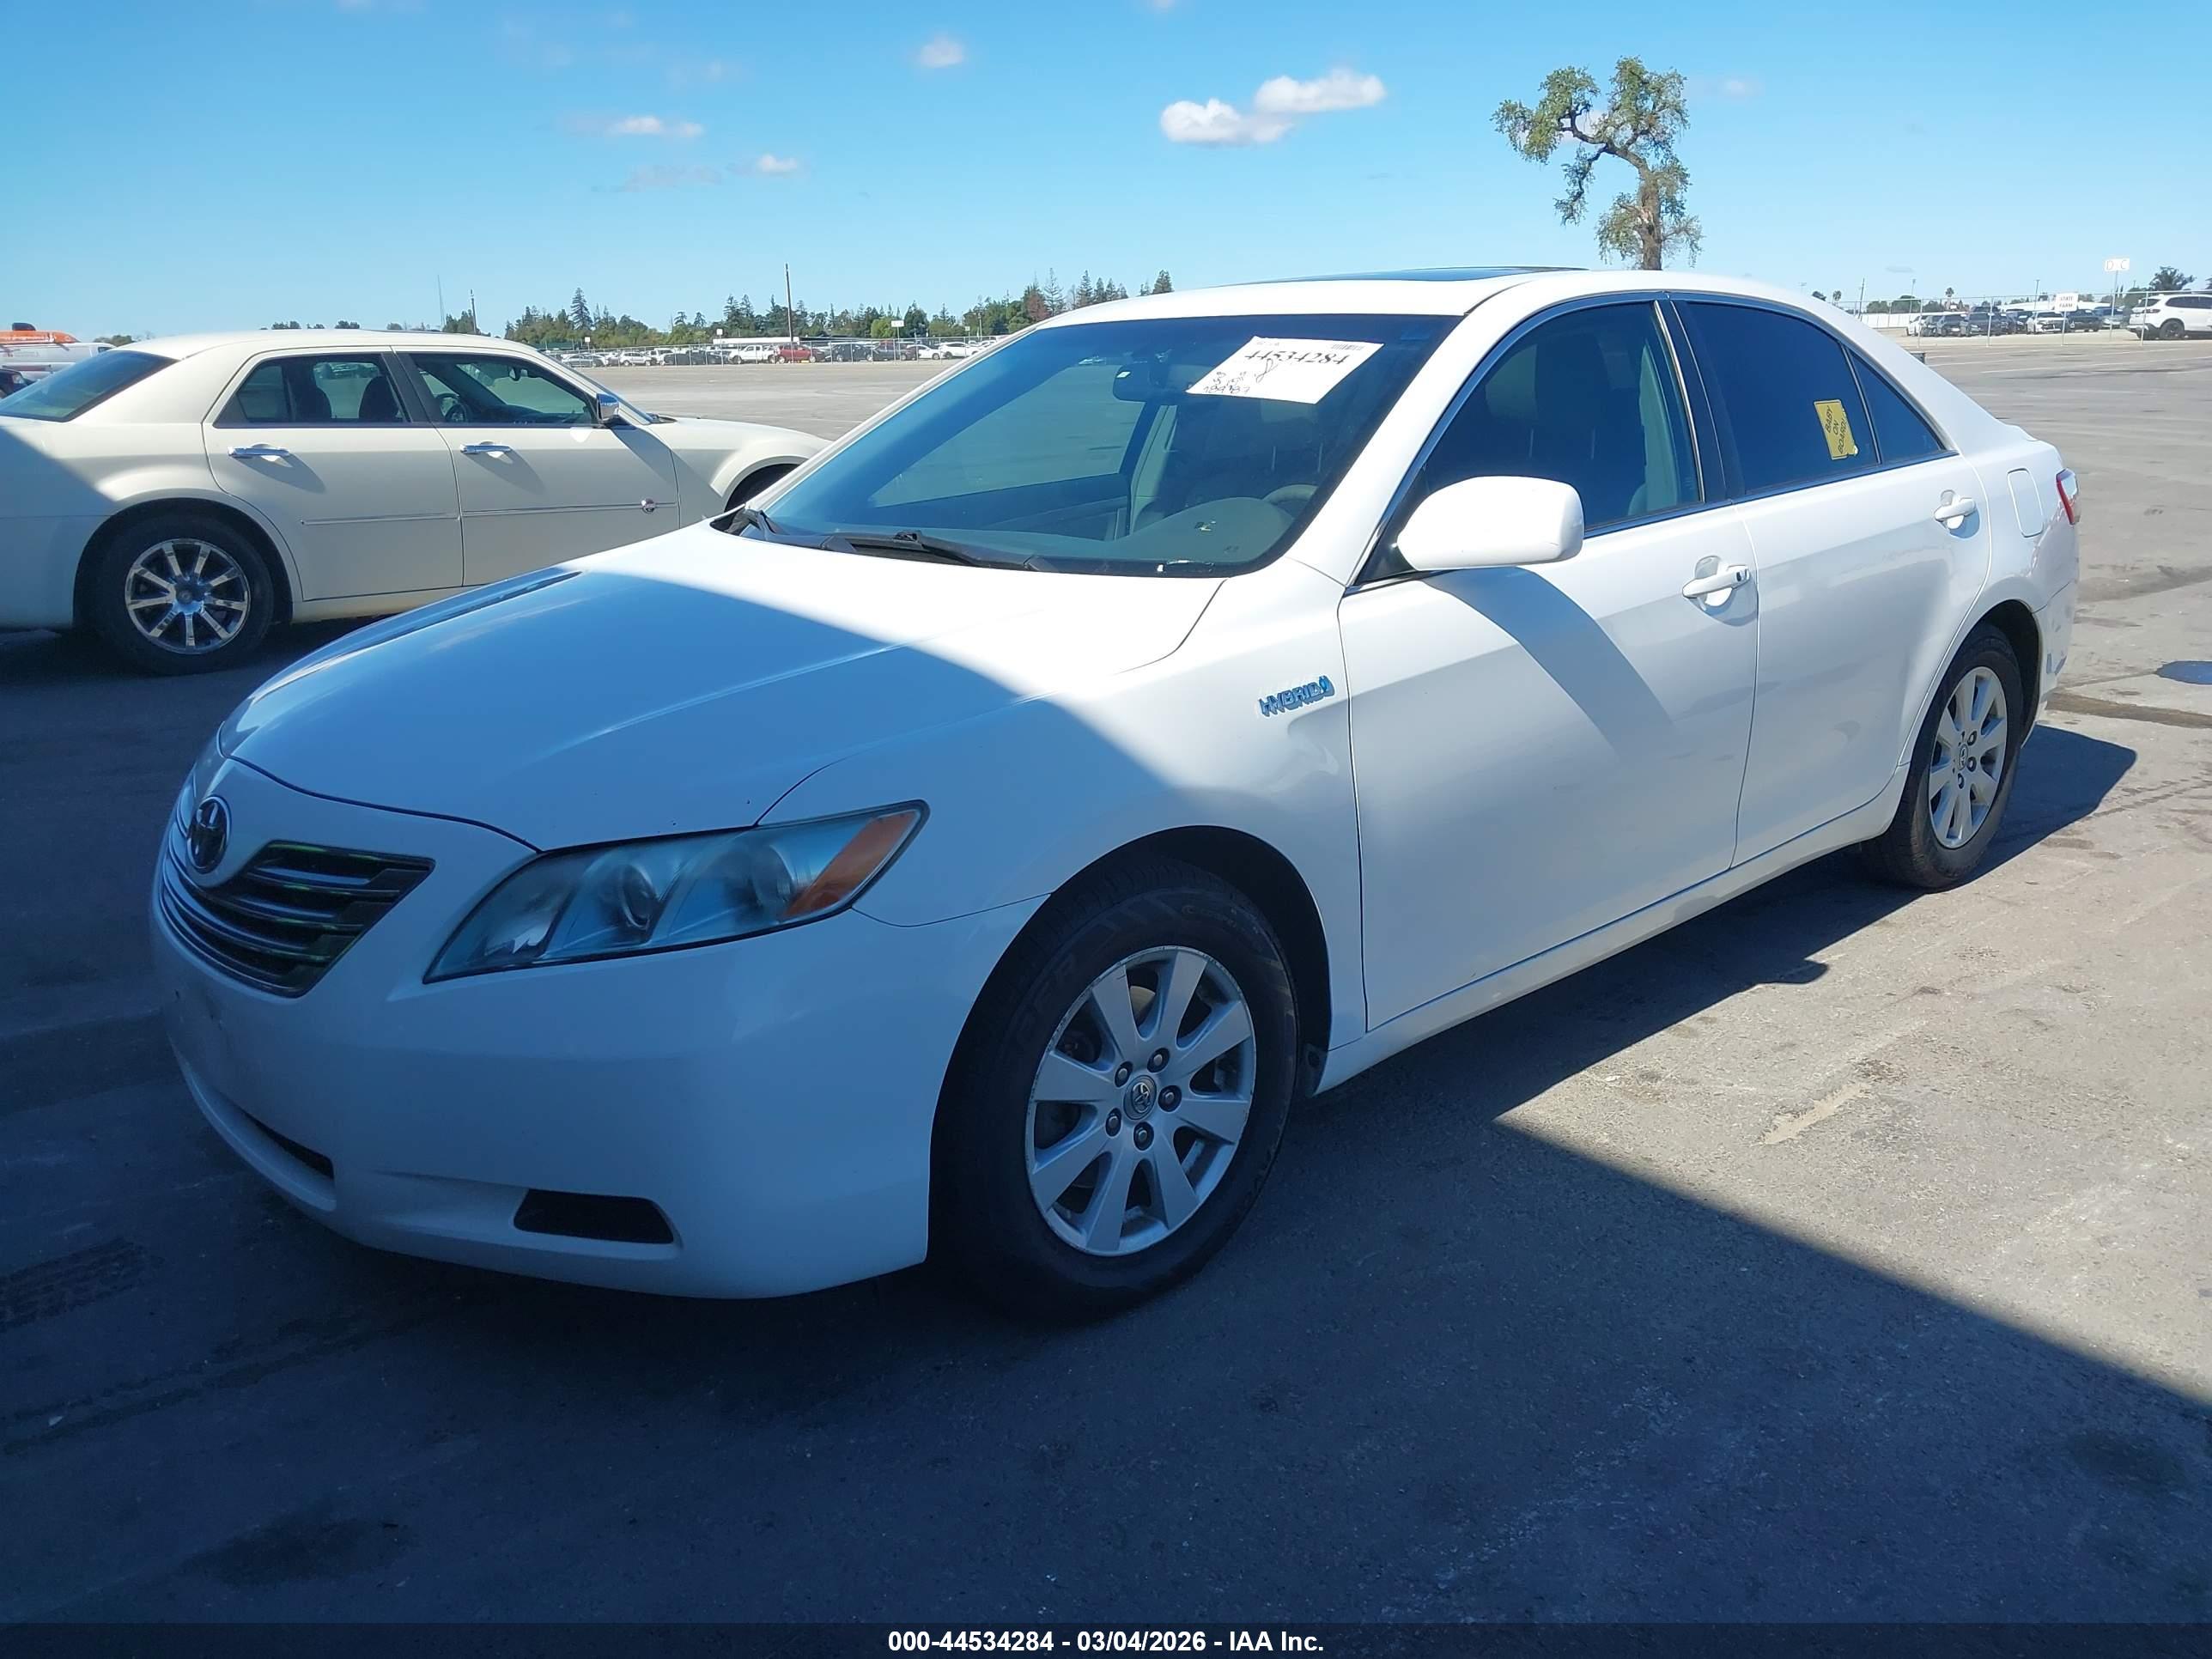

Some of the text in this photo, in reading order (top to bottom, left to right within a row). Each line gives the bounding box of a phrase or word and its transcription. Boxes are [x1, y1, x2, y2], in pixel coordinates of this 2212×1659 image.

[1244, 349, 1351, 365] 44534284
[1825, 405, 1834, 434] BABY
[1832, 419, 1840, 435] ON
[1258, 680, 1327, 717] HYBRID
